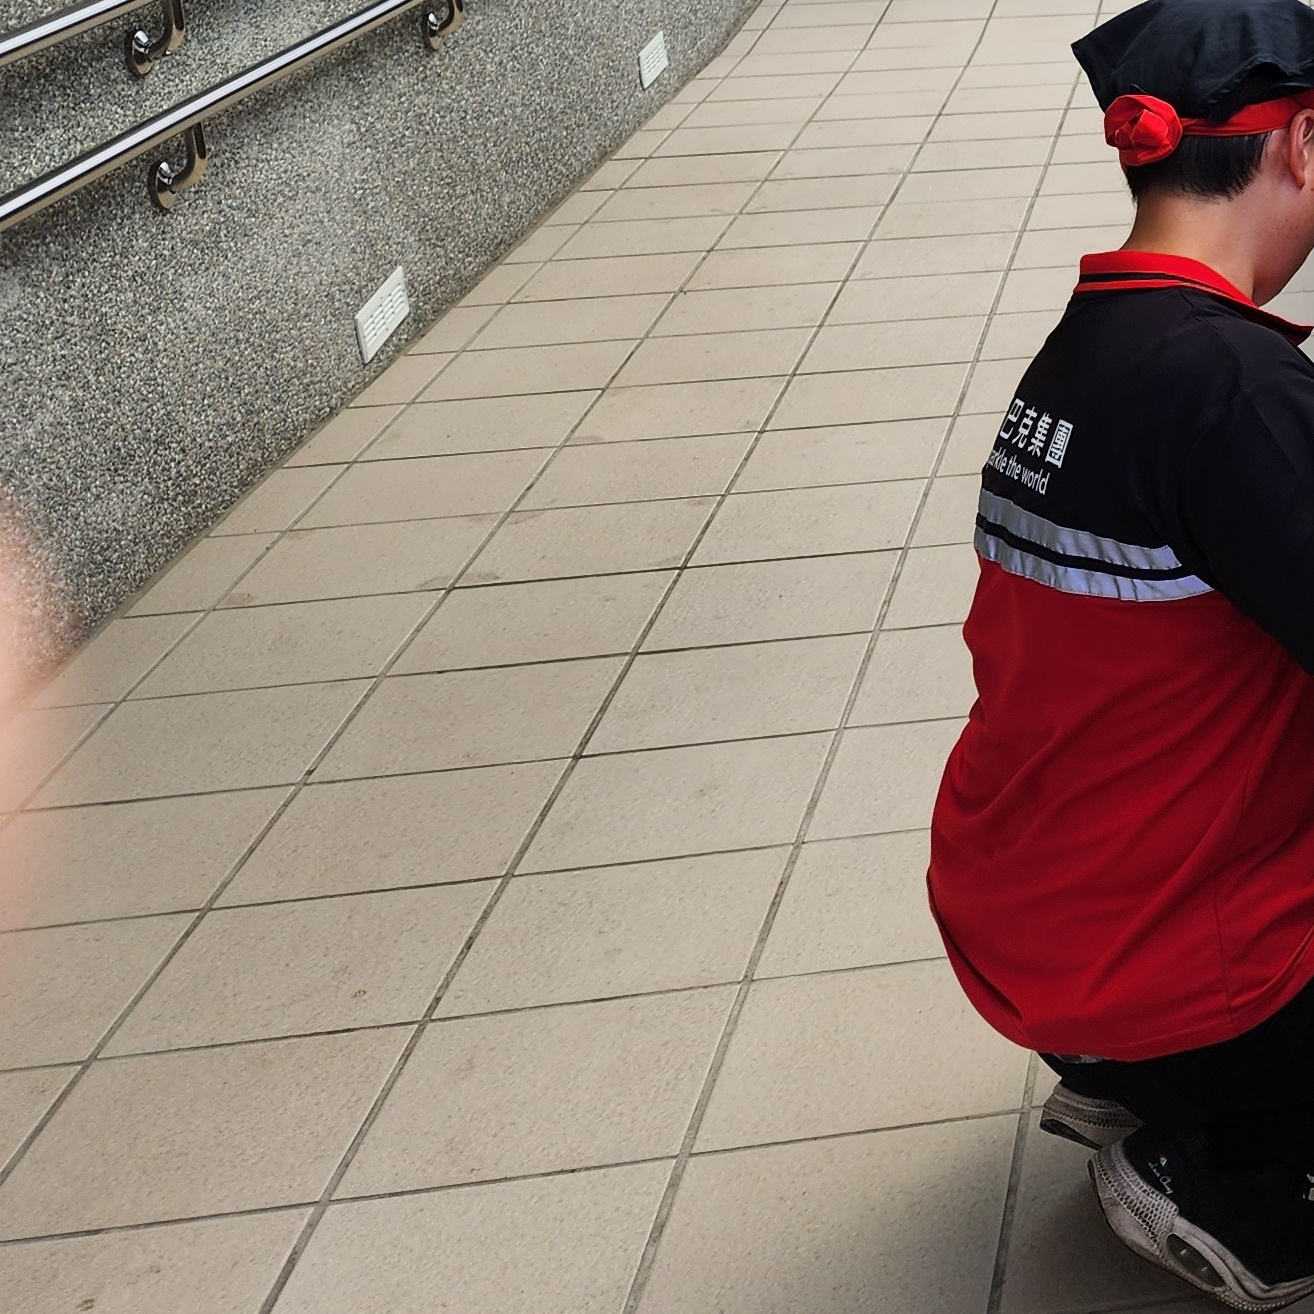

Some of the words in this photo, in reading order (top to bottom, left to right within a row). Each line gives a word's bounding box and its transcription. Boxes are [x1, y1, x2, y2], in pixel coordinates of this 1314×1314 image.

[999, 397, 1074, 469] 巴克集團
[1005, 454, 1022, 481] the
[1021, 468, 1051, 496] world
